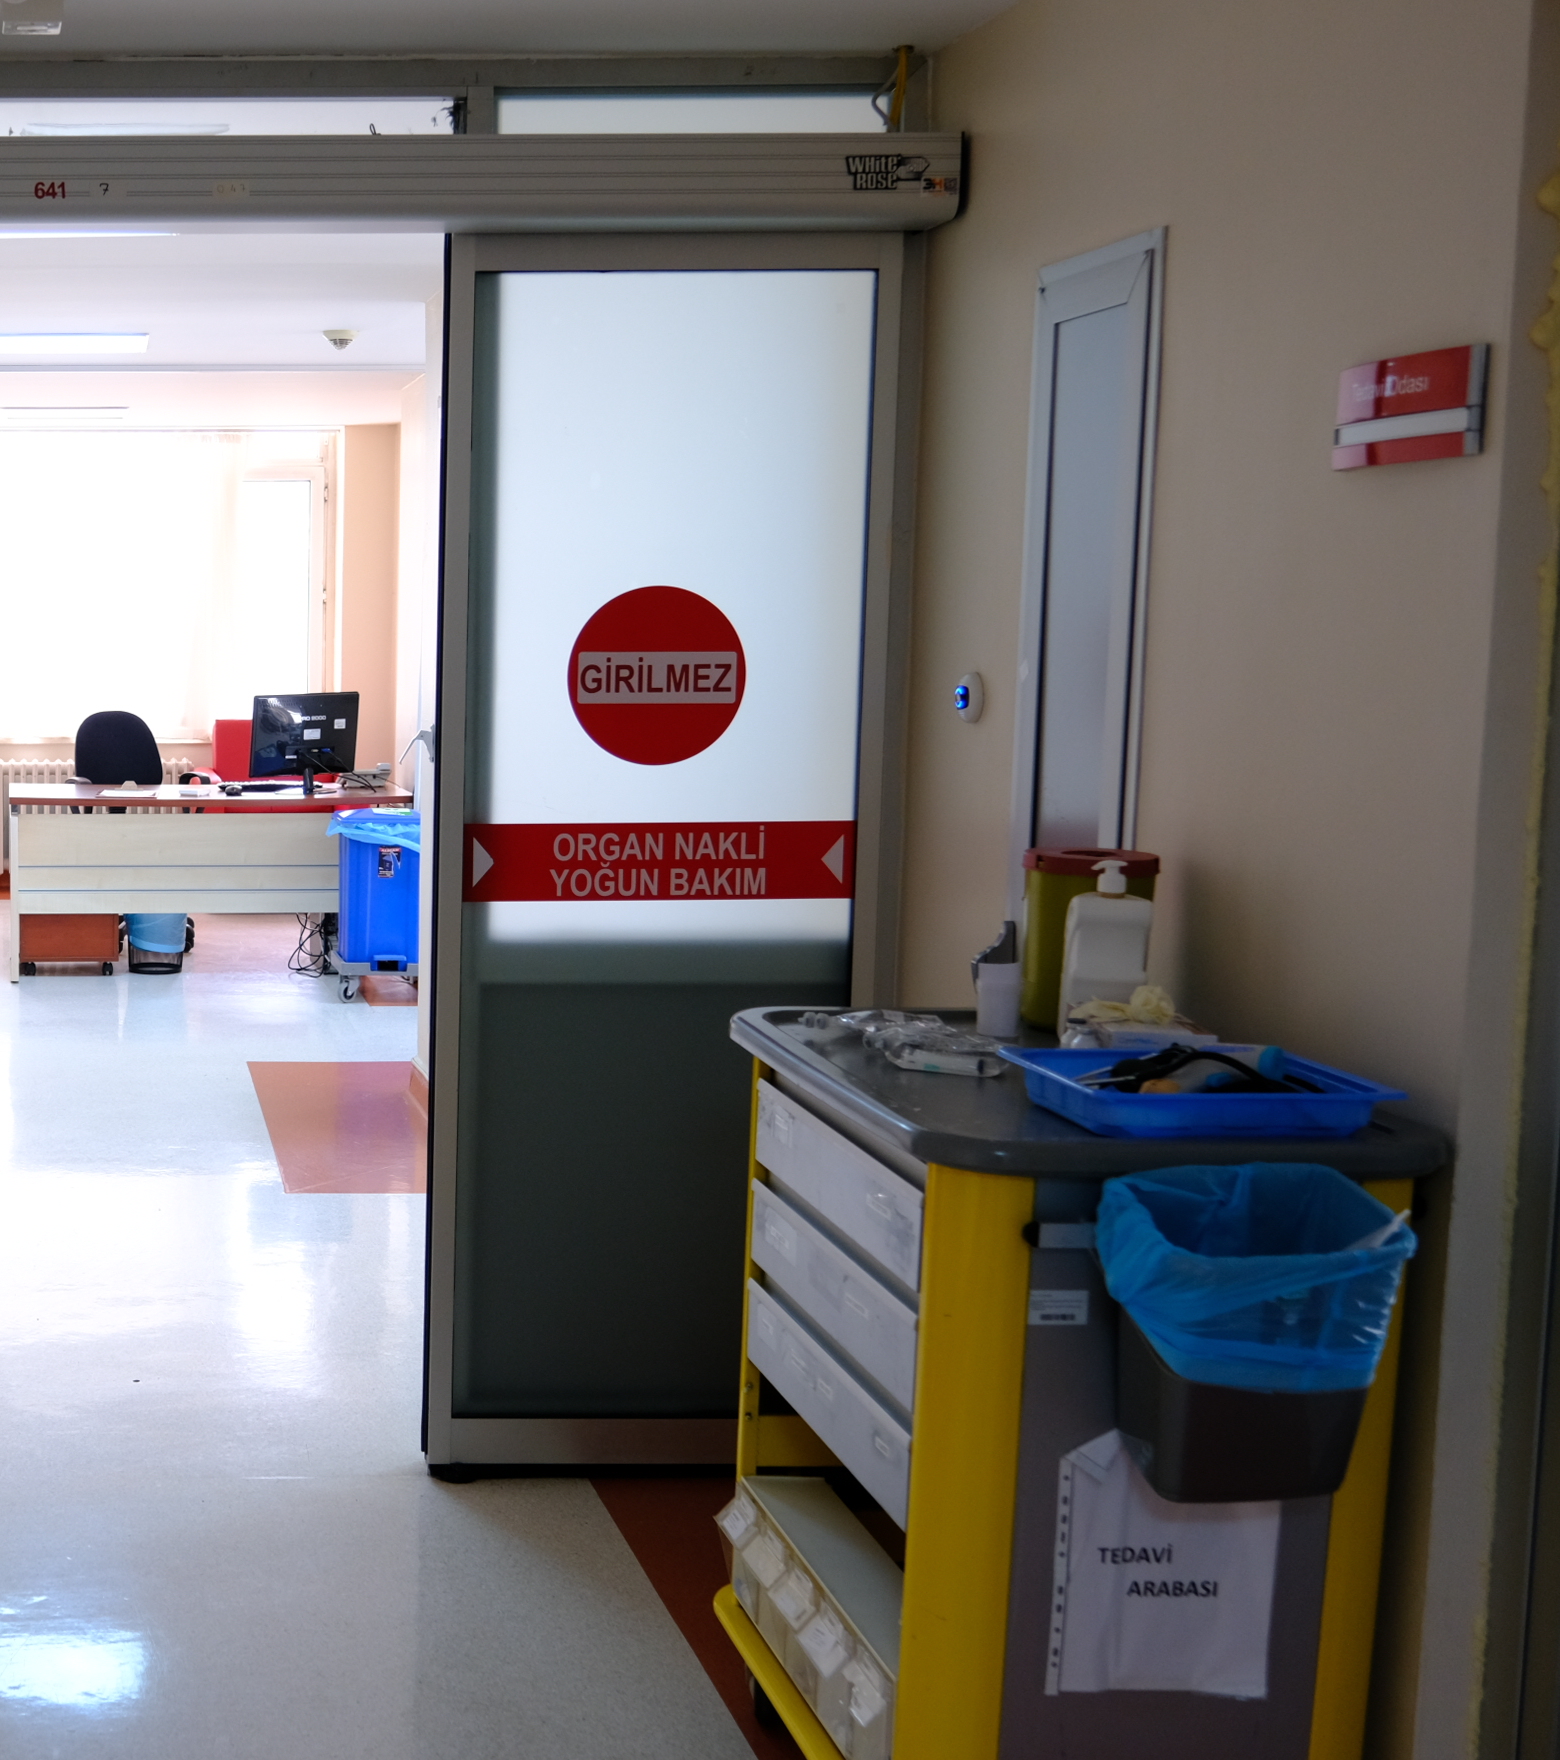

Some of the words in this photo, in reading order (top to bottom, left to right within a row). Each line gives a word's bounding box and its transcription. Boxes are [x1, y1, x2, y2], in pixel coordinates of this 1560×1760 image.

[34, 181, 66, 199] 641
[99, 182, 110, 196] 7
[579, 656, 732, 694] GİRİLMEZ
[552, 833, 664, 861] ORGAN
[674, 825, 766, 860] NAKLİ
[549, 861, 659, 897] YOĞUN
[669, 868, 767, 896] BAKIM
[1097, 1543, 1174, 1565] TEDAVİ
[1126, 1580, 1219, 1598] ARABASI
